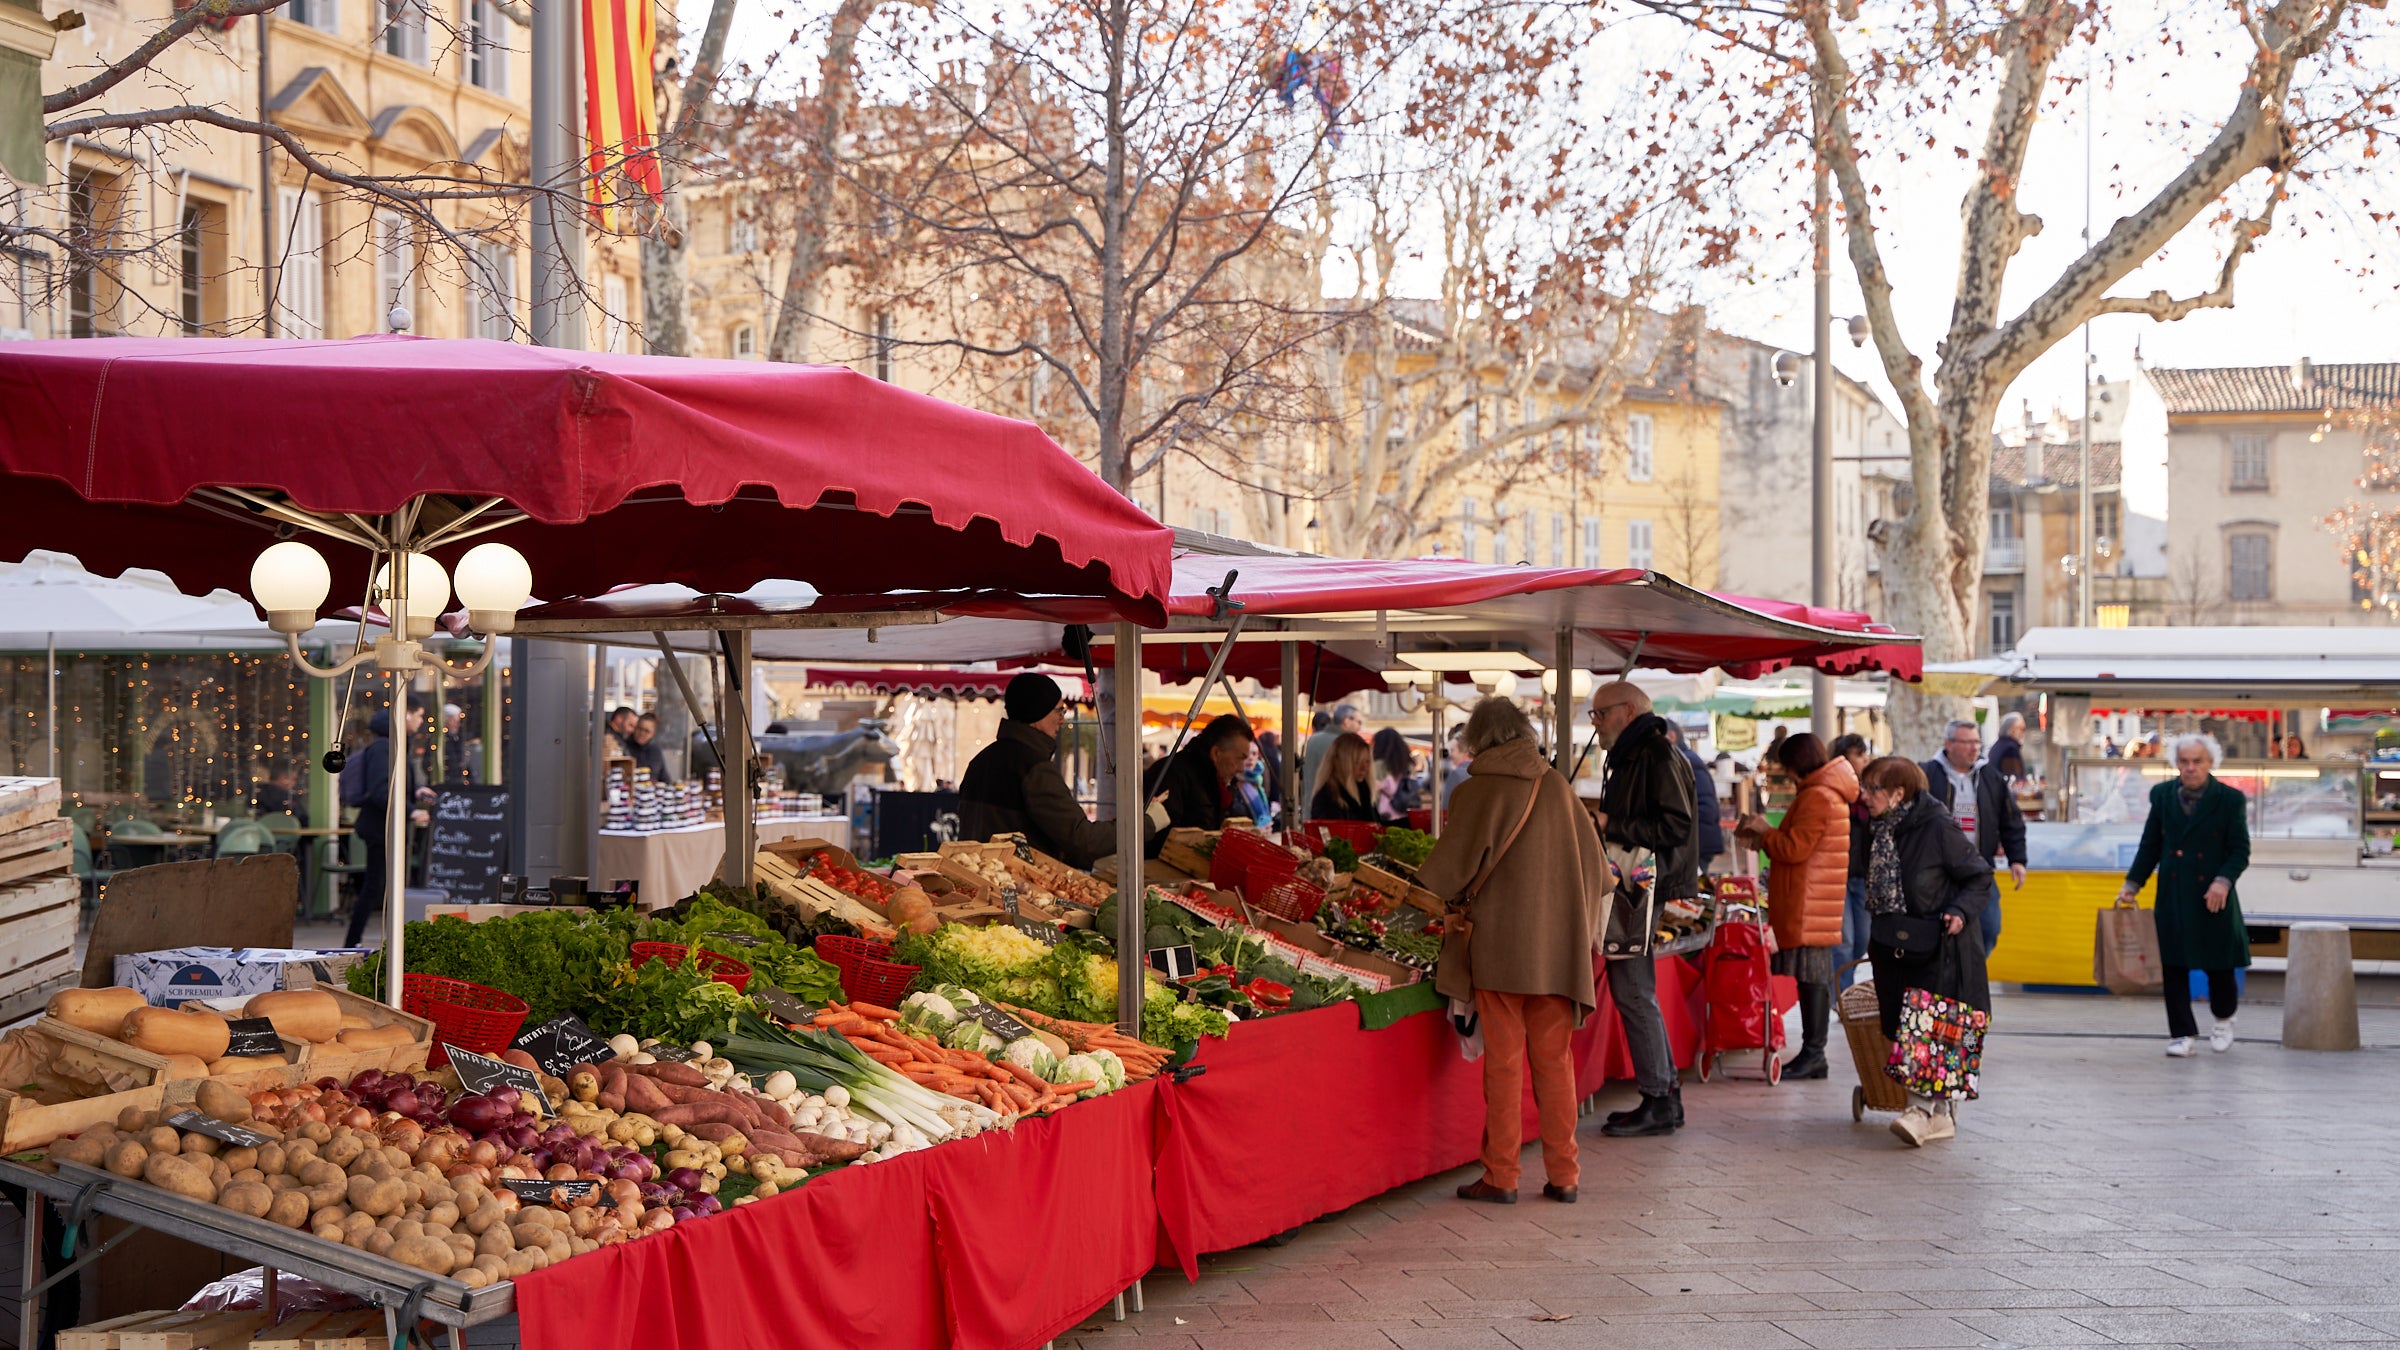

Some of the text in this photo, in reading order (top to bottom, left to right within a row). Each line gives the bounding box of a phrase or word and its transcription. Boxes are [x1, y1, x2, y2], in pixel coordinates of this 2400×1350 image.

[168, 988, 222, 997] SCB PREMIUM
[449, 1048, 533, 1080] AMANDINE
